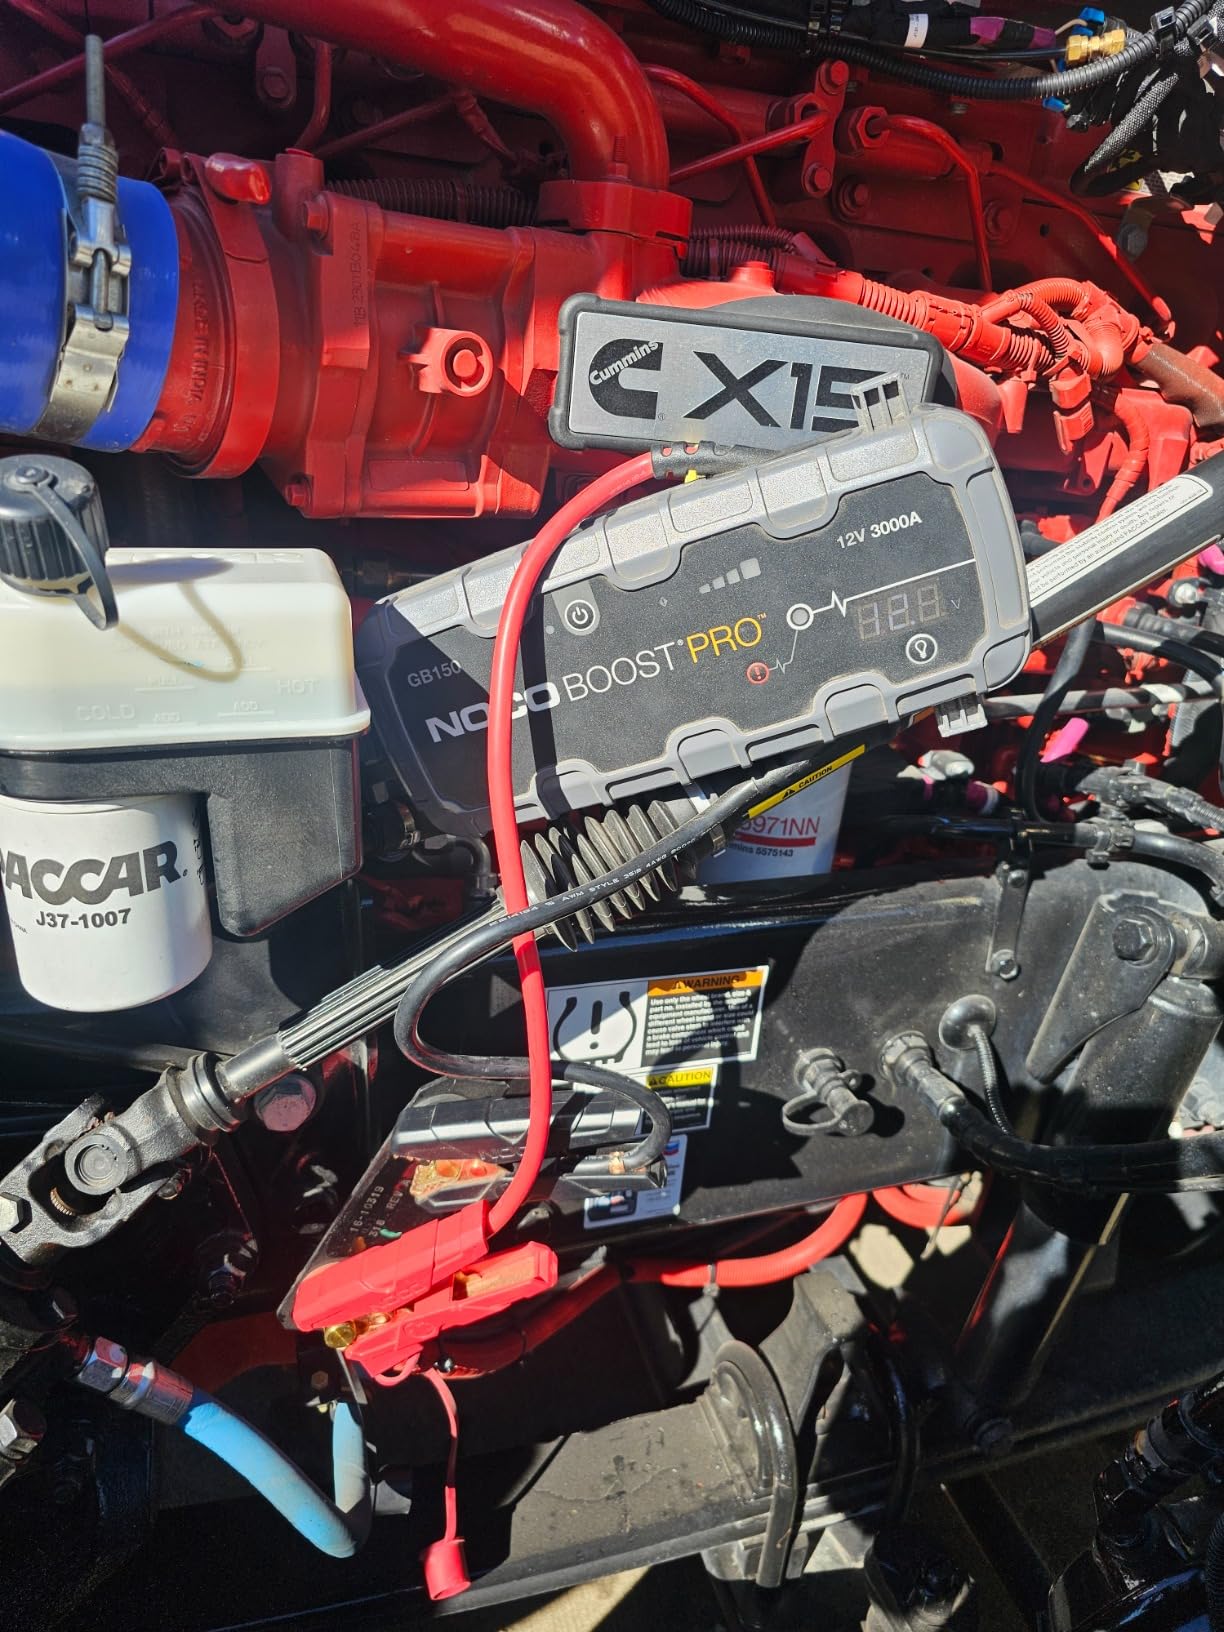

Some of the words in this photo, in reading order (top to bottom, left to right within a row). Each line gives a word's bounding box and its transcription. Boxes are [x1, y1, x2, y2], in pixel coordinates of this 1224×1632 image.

[589, 341, 659, 386] Cummins
[683, 350, 898, 433] X15
[837, 528, 865, 549] 12V
[870, 511, 922, 538] 3000A
[562, 642, 676, 701] BOOST
[685, 617, 763, 664] PRO
[407, 660, 462, 688] GB150
[276, 678, 321, 696] HOT
[75, 703, 136, 722] COLD
[798, 765, 833, 789] CAUTION
[755, 847, 794, 858] 5575143
[0, 840, 182, 906] ACCAR
[36, 908, 132, 929] J37-1007
[684, 974, 741, 988] WARNING
[658, 1070, 713, 1086] CAUTION
